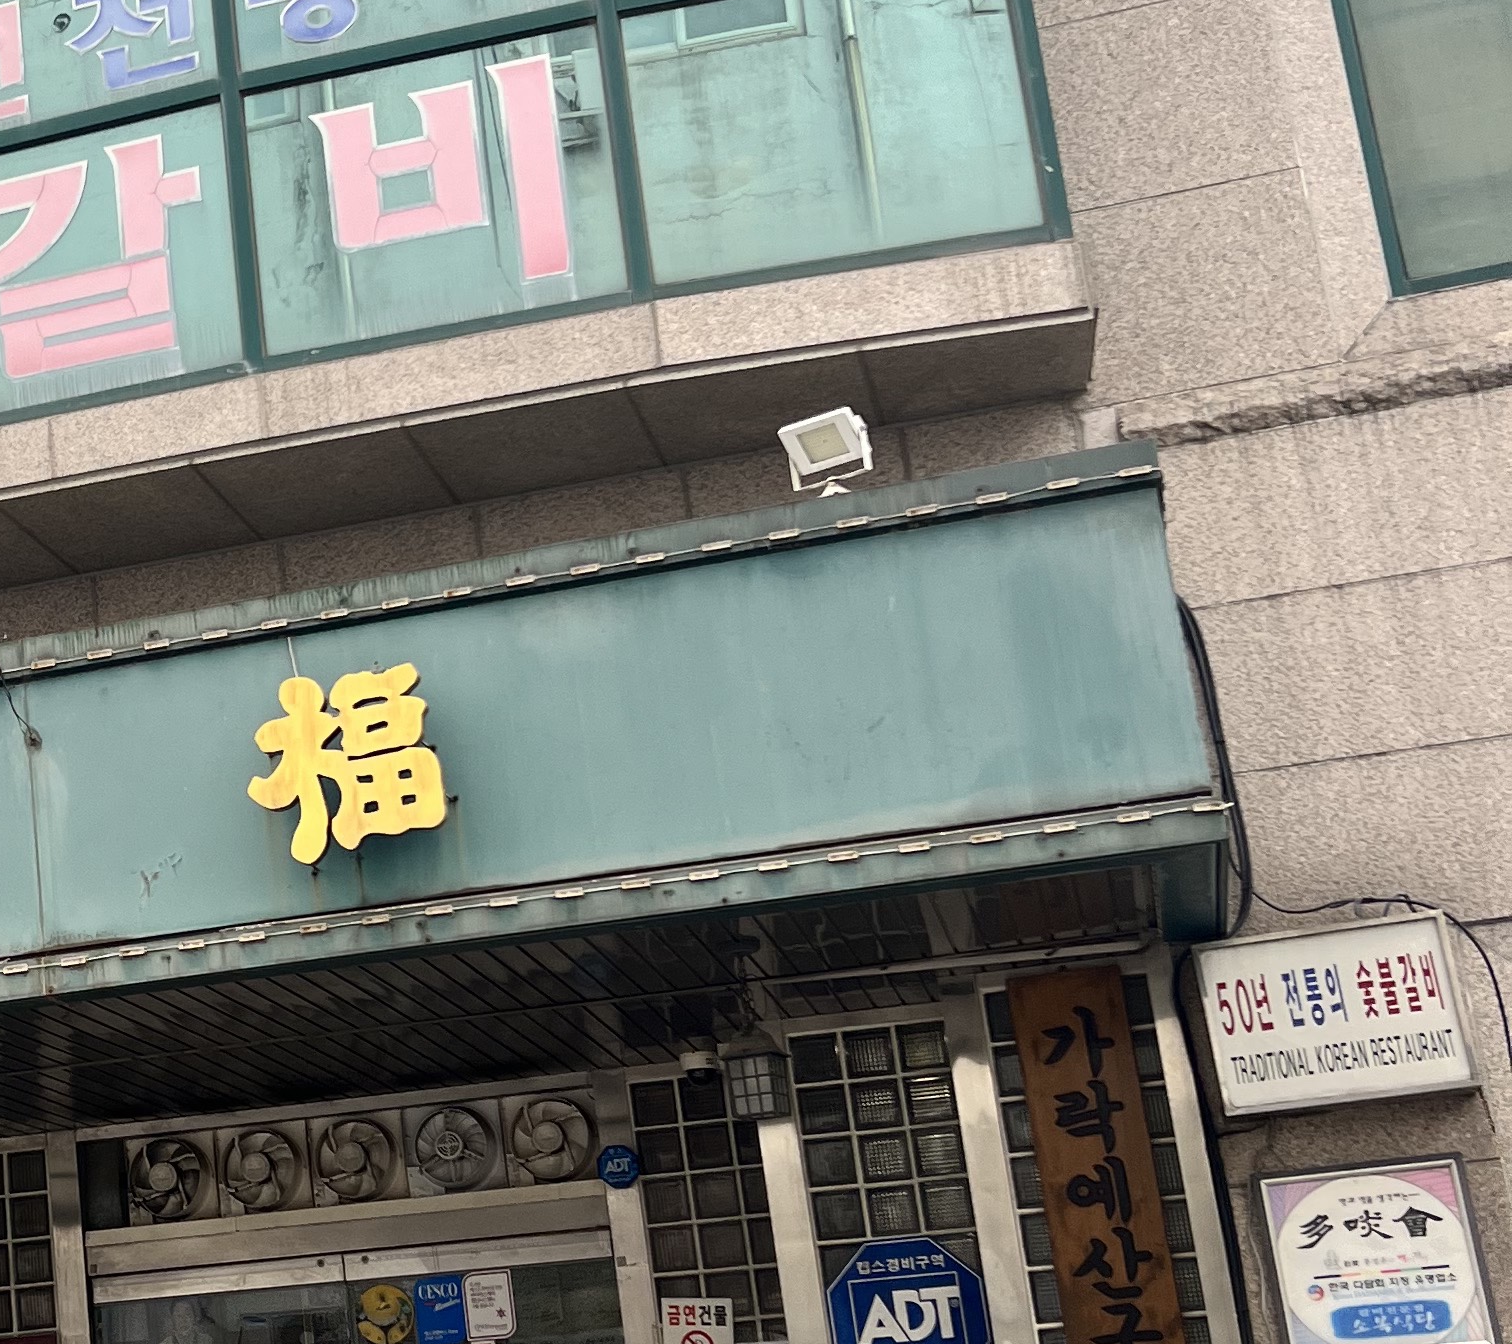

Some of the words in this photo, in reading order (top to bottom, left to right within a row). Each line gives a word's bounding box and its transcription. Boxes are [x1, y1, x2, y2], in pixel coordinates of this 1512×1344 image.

[1216, 973, 1274, 1036] 50년
[1280, 963, 1349, 1027] 전통의
[1356, 950, 1445, 1019] 숯불갈비
[1230, 1047, 1314, 1084] TRADITIONAL
[1314, 1039, 1371, 1074] KOREAN
[1369, 1029, 1457, 1066] RESTAURANT
[604, 1158, 631, 1174] ADT
[418, 1282, 458, 1300] CESCO
[1328, 1281, 1349, 1292] 한국
[667, 1304, 727, 1326] 금연건물
